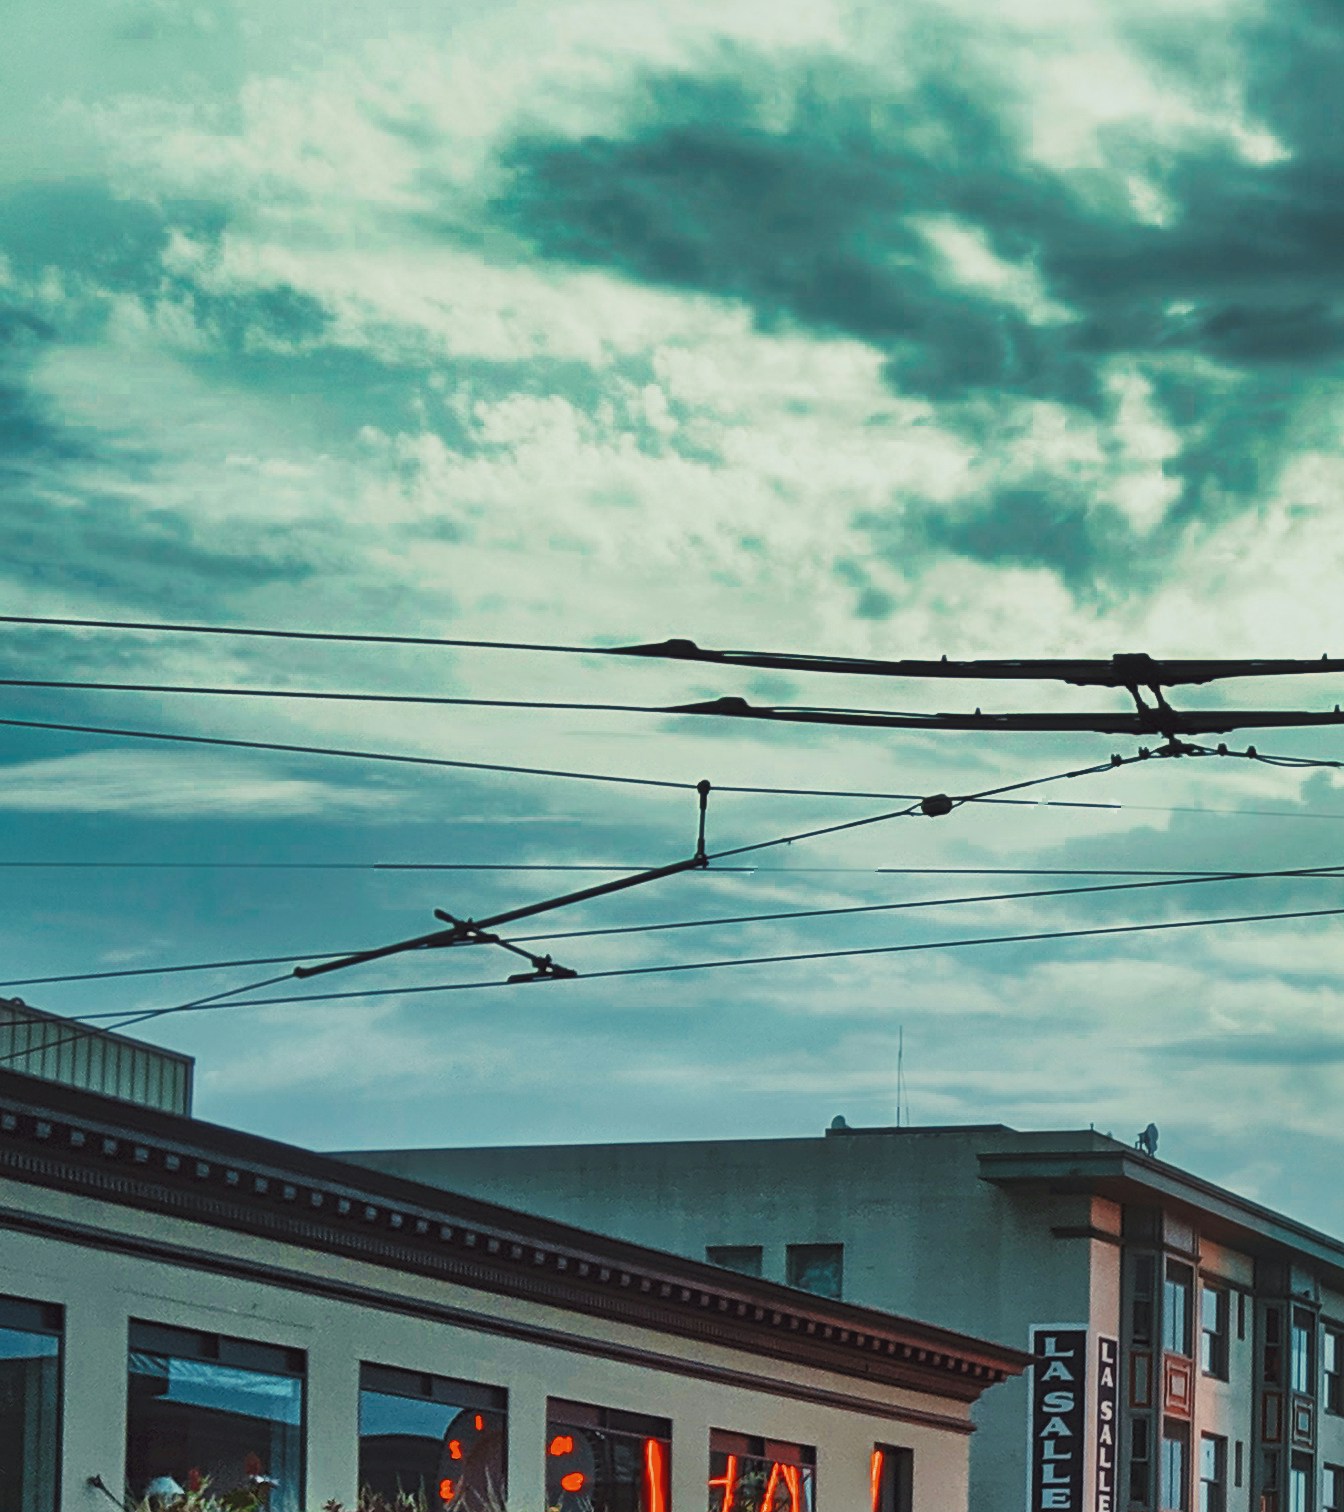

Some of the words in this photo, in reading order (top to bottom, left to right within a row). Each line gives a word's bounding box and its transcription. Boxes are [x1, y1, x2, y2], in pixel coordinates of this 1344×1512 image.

[1040, 1337, 1075, 1381] LA
[1101, 1342, 1113, 1387] LA
[1039, 1391, 1075, 1509] SALLE
